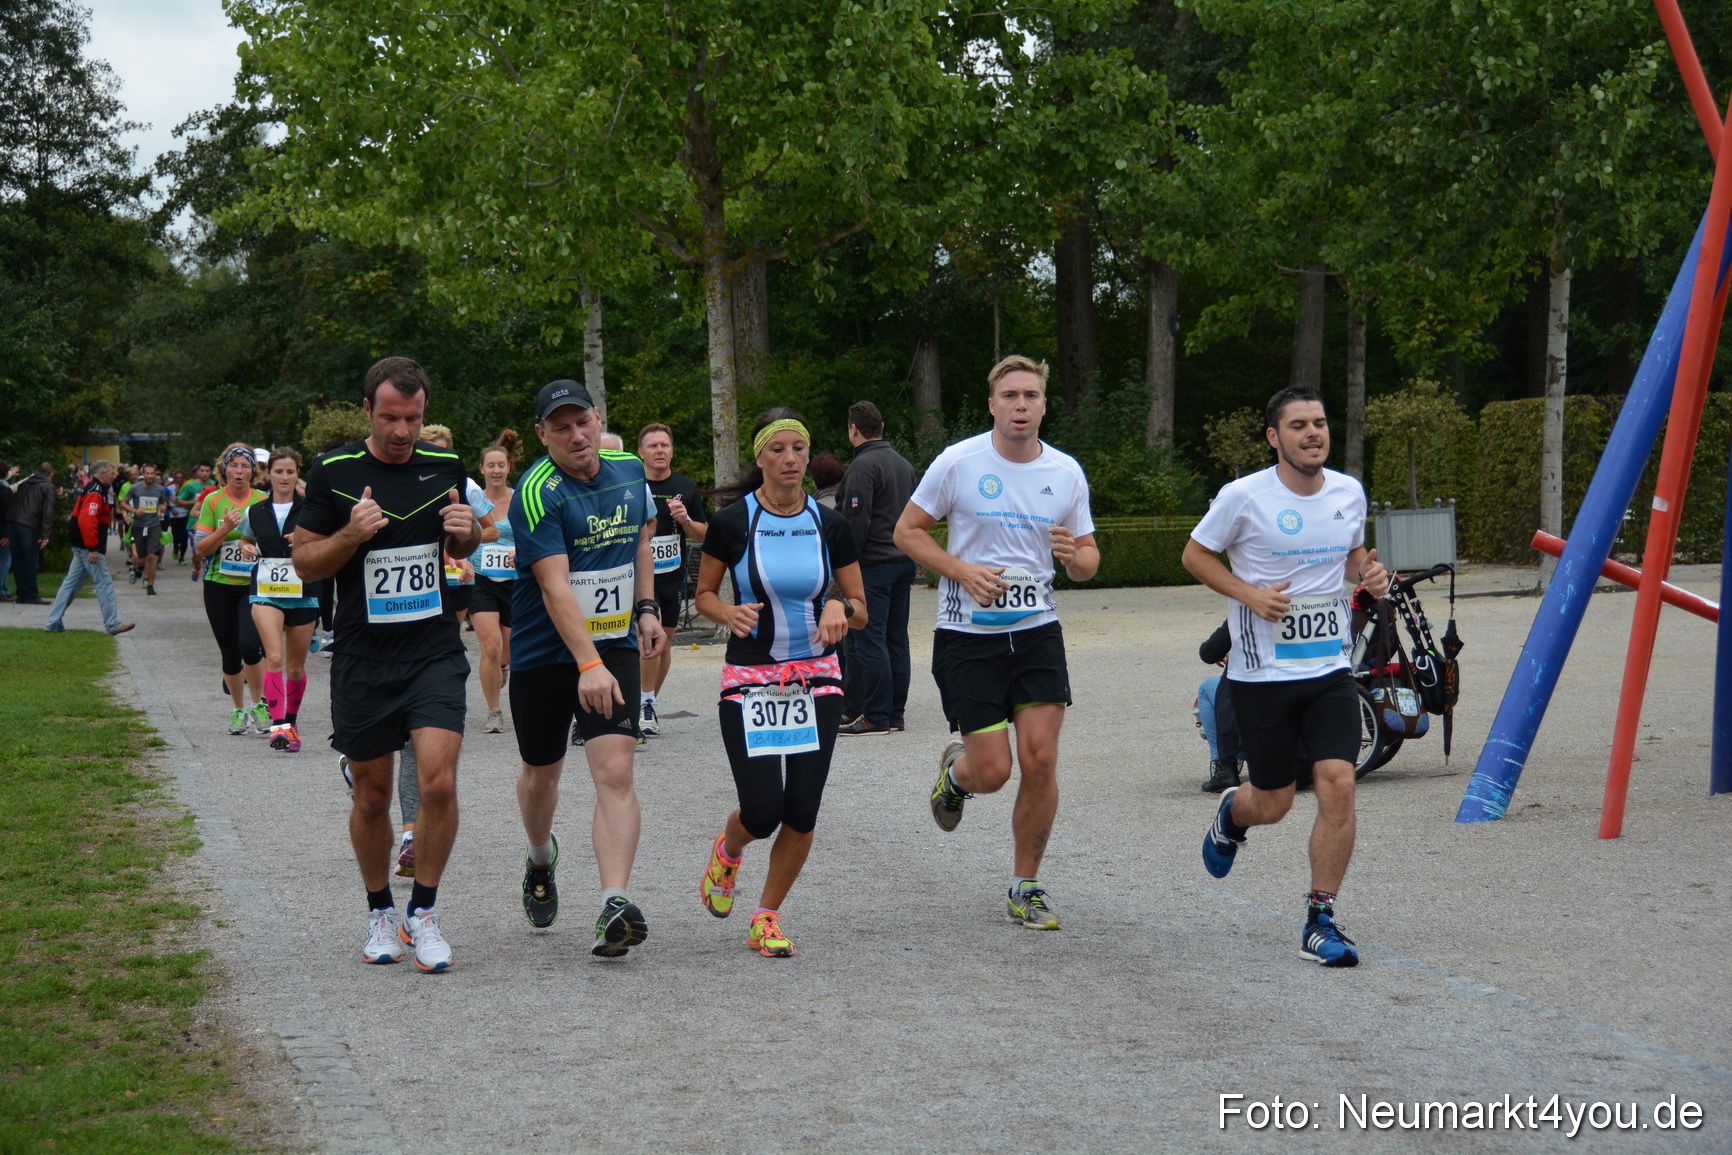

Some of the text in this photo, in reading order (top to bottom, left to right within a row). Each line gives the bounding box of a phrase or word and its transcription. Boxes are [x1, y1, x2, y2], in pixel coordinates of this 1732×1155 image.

[366, 553, 431, 565] PARTL Neumarkt
[655, 561, 675, 569] Manfred
[1307, 557, 1320, 565] April
[270, 567, 289, 582] 62
[374, 562, 435, 595] 2788
[570, 573, 627, 586] PARTL Neumarkt
[998, 574, 1032, 582] Neumarkt
[269, 585, 290, 593] Kerstin
[979, 584, 1037, 608] 036
[385, 598, 430, 612] Christian
[594, 585, 620, 614] 21
[1301, 601, 1331, 611] Neumarkt
[590, 618, 626, 632] Thomas
[1281, 610, 1339, 640] 3028
[751, 698, 808, 727] 3073
